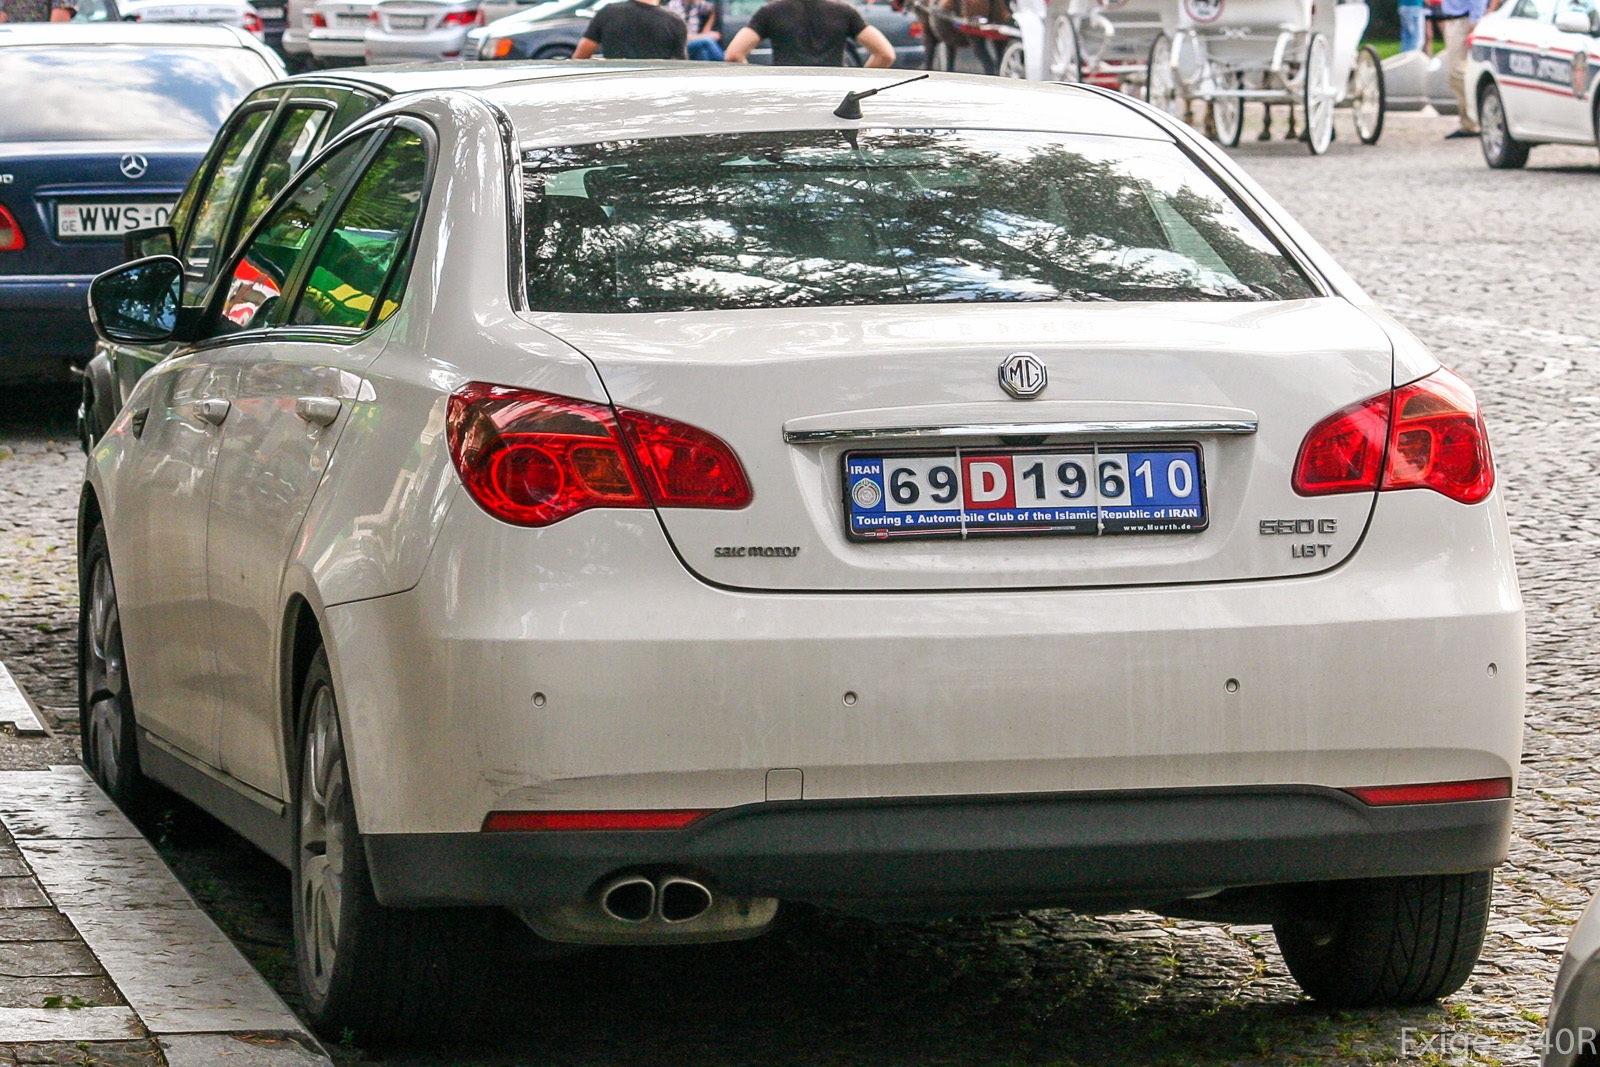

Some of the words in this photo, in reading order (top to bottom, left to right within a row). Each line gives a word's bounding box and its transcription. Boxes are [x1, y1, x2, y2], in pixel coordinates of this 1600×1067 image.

[62, 220, 77, 232] GE
[1009, 359, 1040, 388] MG
[850, 465, 880, 475] IRAN
[856, 515, 901, 526] Touring
[905, 514, 914, 524] &
[918, 513, 985, 524] Automobile
[987, 512, 1014, 521] Club
[1017, 511, 1030, 521] of
[1033, 511, 1052, 520] the
[1055, 510, 1098, 520] Islamic
[1101, 509, 1151, 520] Republic
[1153, 509, 1166, 518] of
[1168, 508, 1198, 518] IRAN
[748, 546, 800, 557] motor
